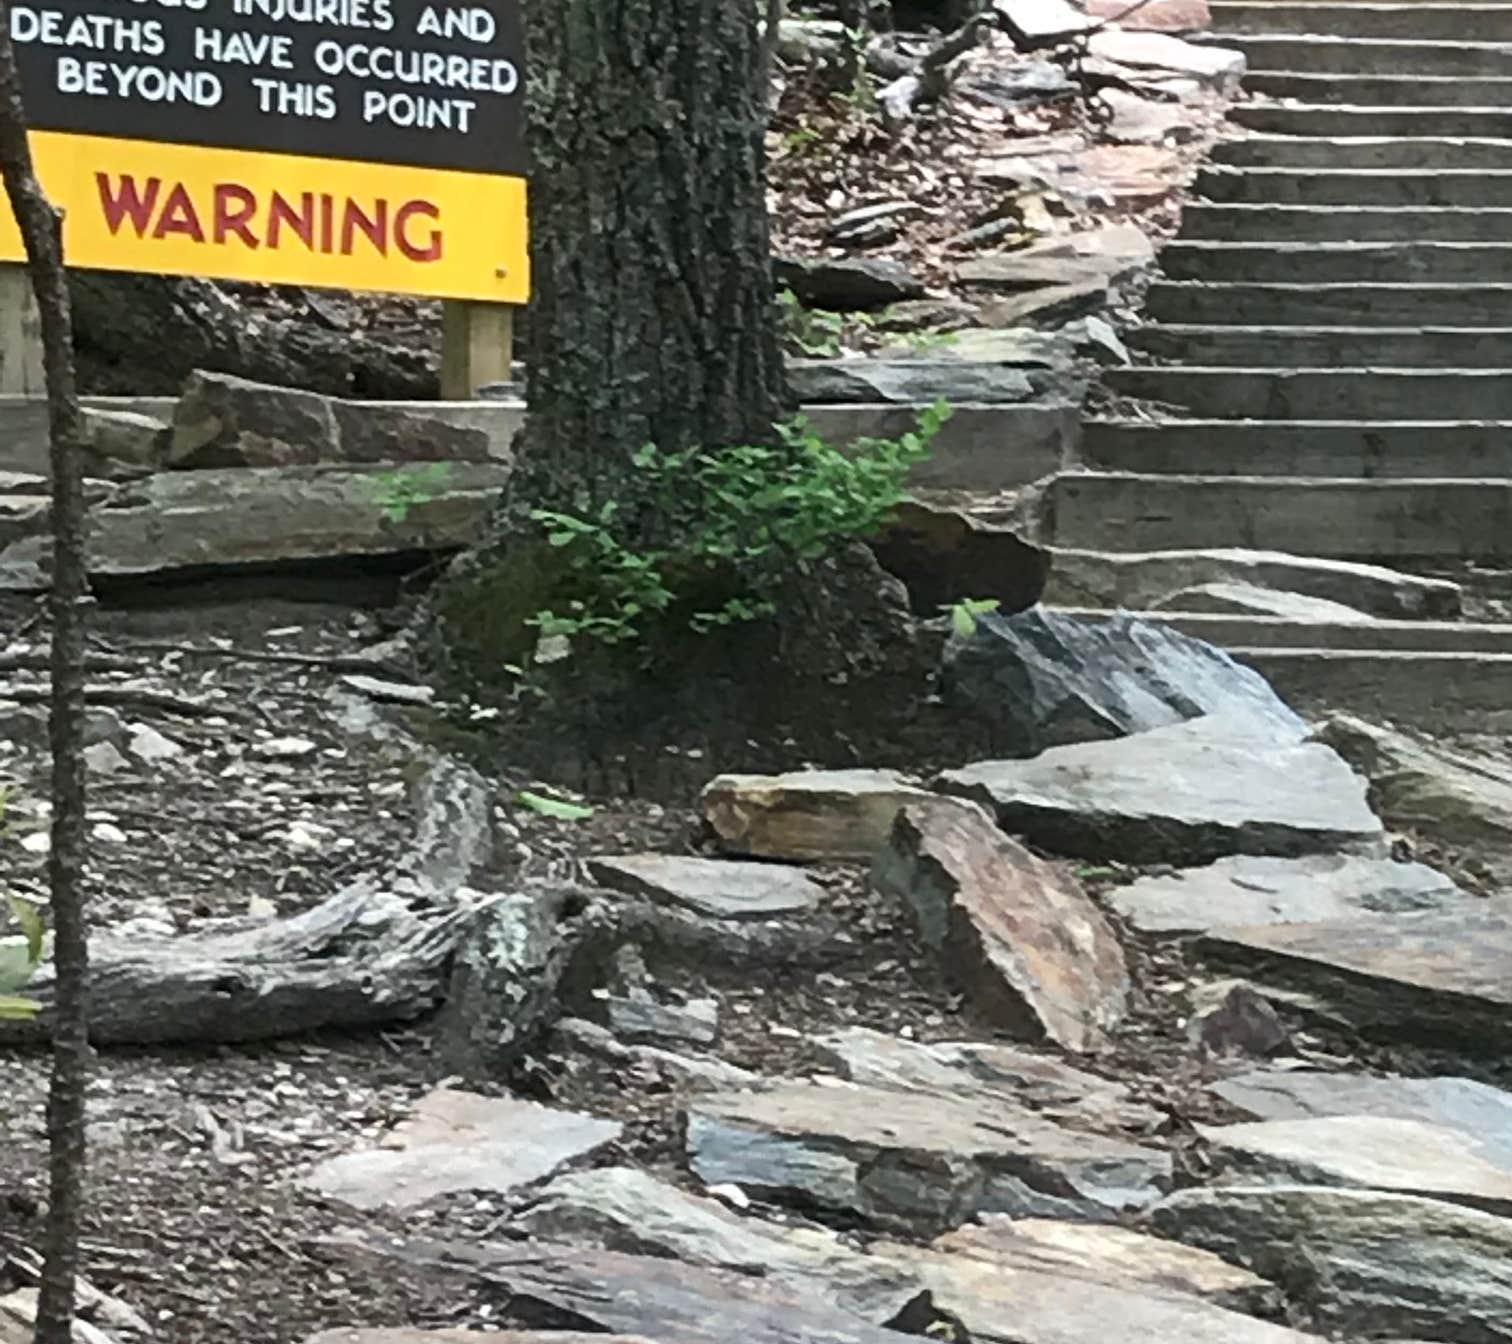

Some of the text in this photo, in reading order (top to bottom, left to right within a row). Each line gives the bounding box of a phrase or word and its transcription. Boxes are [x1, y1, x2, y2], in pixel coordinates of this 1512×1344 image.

[10, 8, 518, 94] DEATHS HAVE OCCURRED
[416, 7, 496, 43] AND
[58, 57, 476, 133] BEYOND THIS POINT
[96, 172, 442, 263] WARNING
